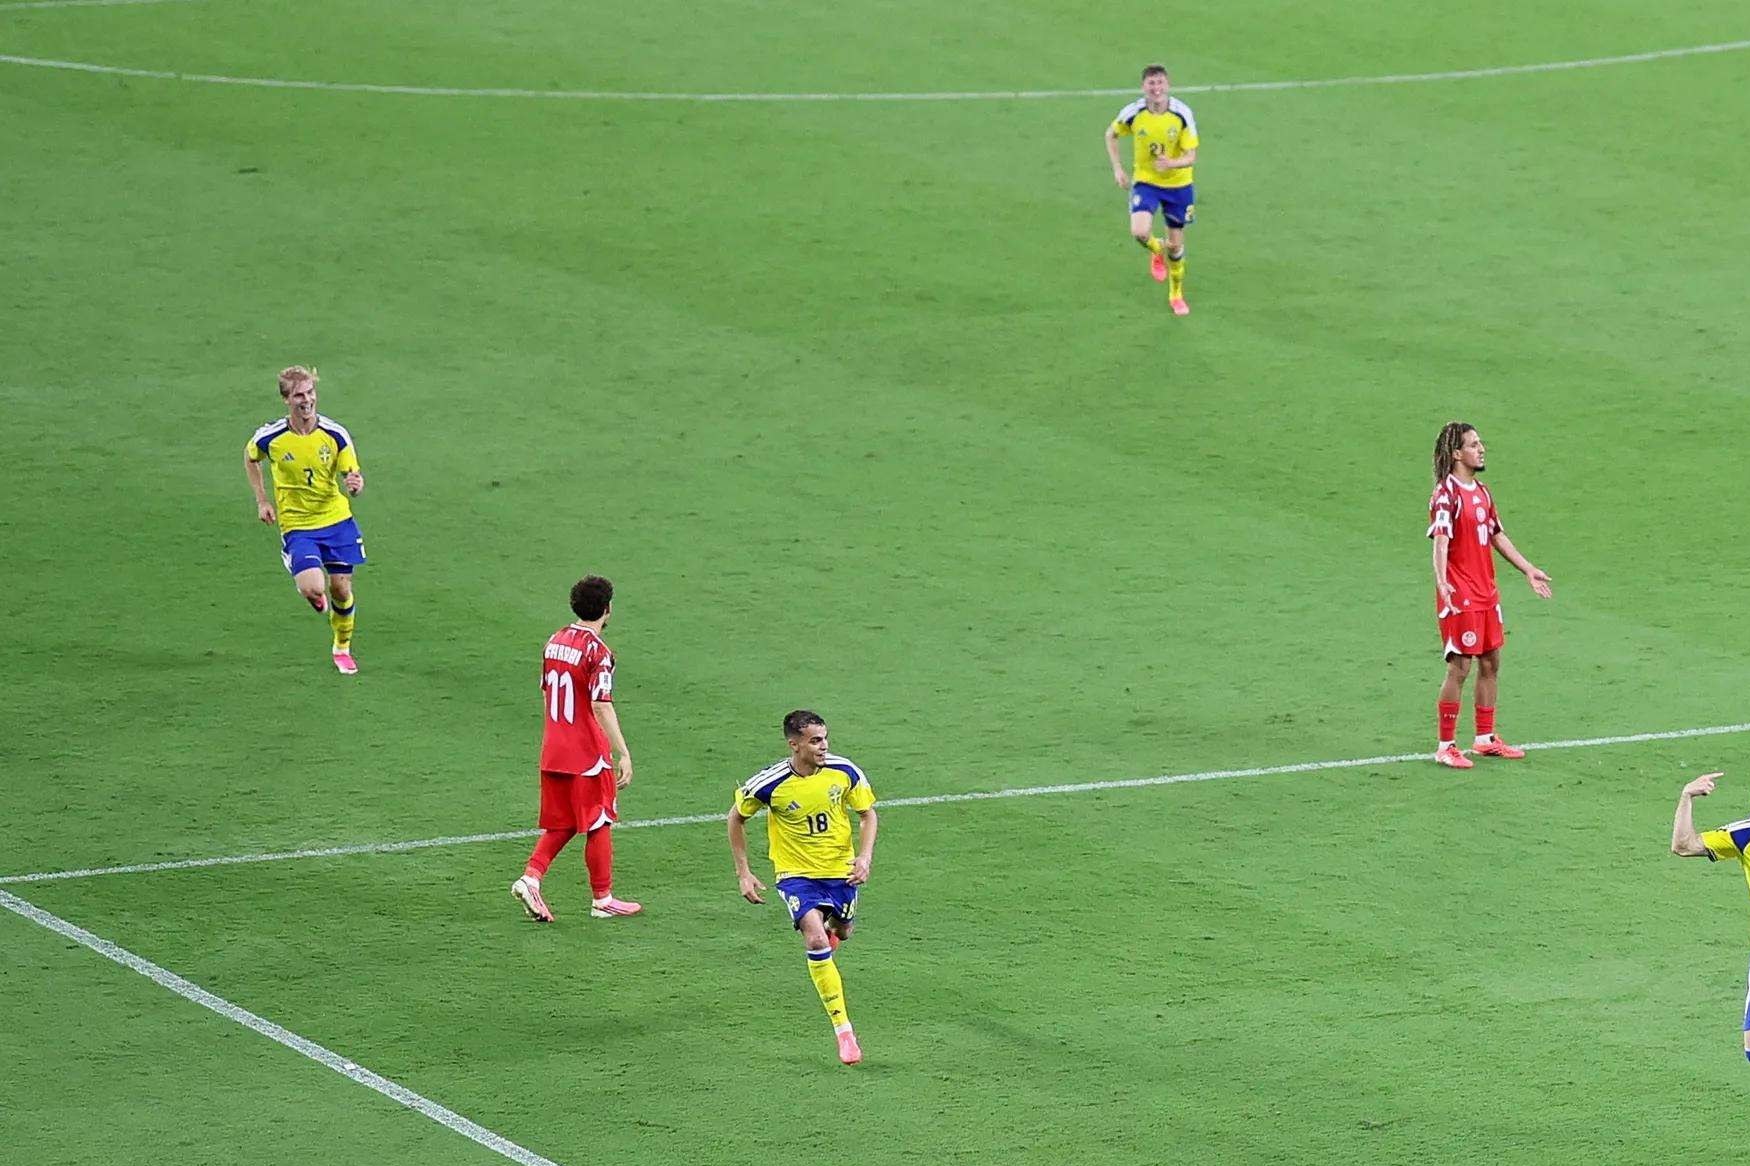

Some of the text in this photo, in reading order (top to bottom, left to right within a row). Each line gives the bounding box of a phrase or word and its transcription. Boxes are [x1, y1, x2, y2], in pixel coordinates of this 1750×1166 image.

[303, 467, 314, 487] 7
[546, 669, 575, 724] 11
[806, 812, 829, 835] 18
